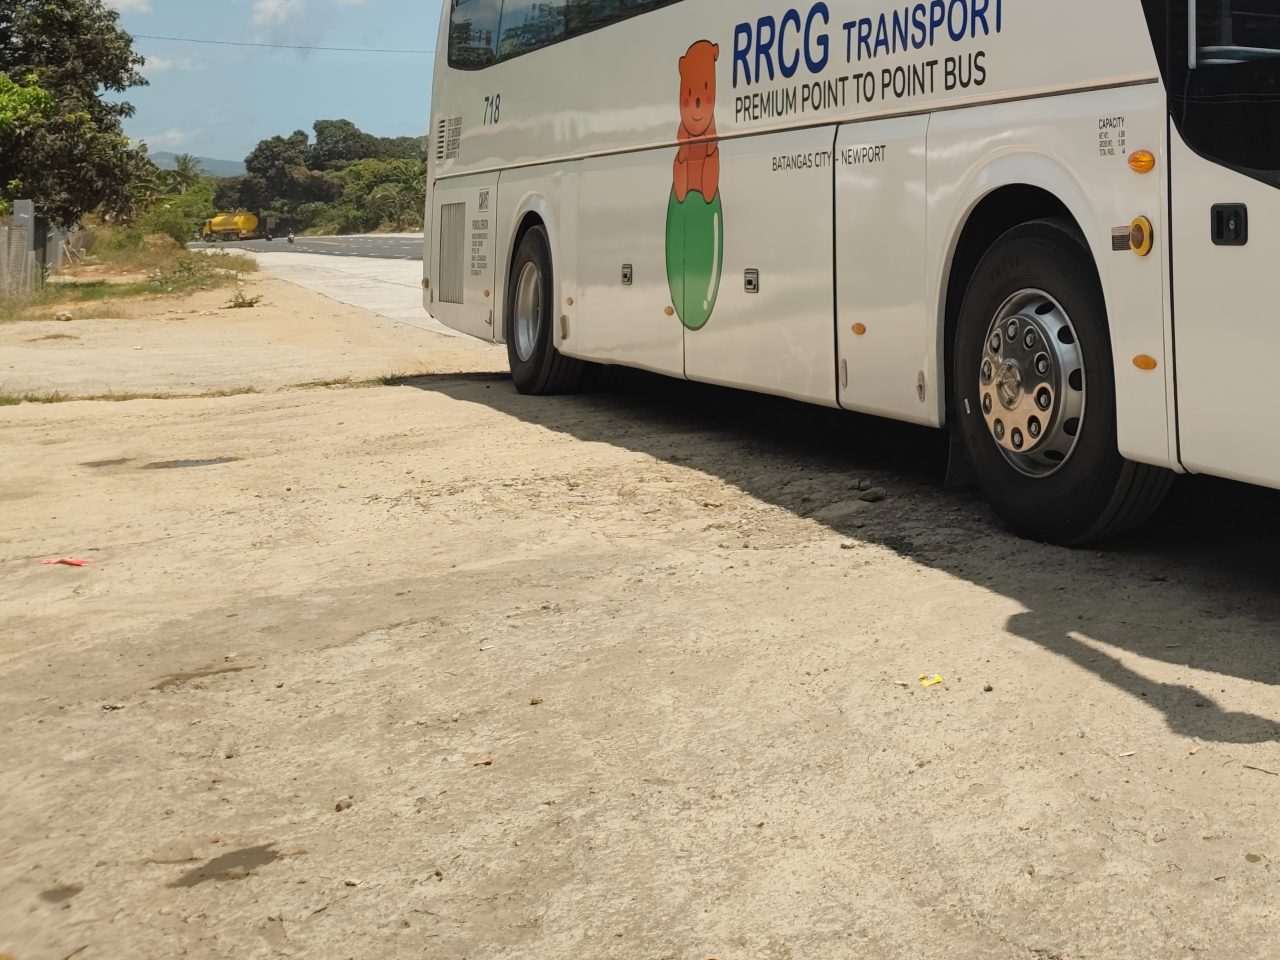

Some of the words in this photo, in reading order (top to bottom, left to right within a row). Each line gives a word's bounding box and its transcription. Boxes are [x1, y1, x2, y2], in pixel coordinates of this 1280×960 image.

[732, 1, 830, 89] RRCG
[735, 86, 797, 123] PREMIUM
[801, 75, 849, 113] POINT
[853, 71, 876, 104] TO
[882, 59, 938, 100] POINT
[944, 50, 987, 91] BUS
[483, 93, 500, 126] 718
[1099, 116, 1125, 130] CAPACITY
[772, 152, 813, 172] BATANGAS
[814, 150, 833, 168] CITY
[841, 144, 886, 166] NEWPORT
